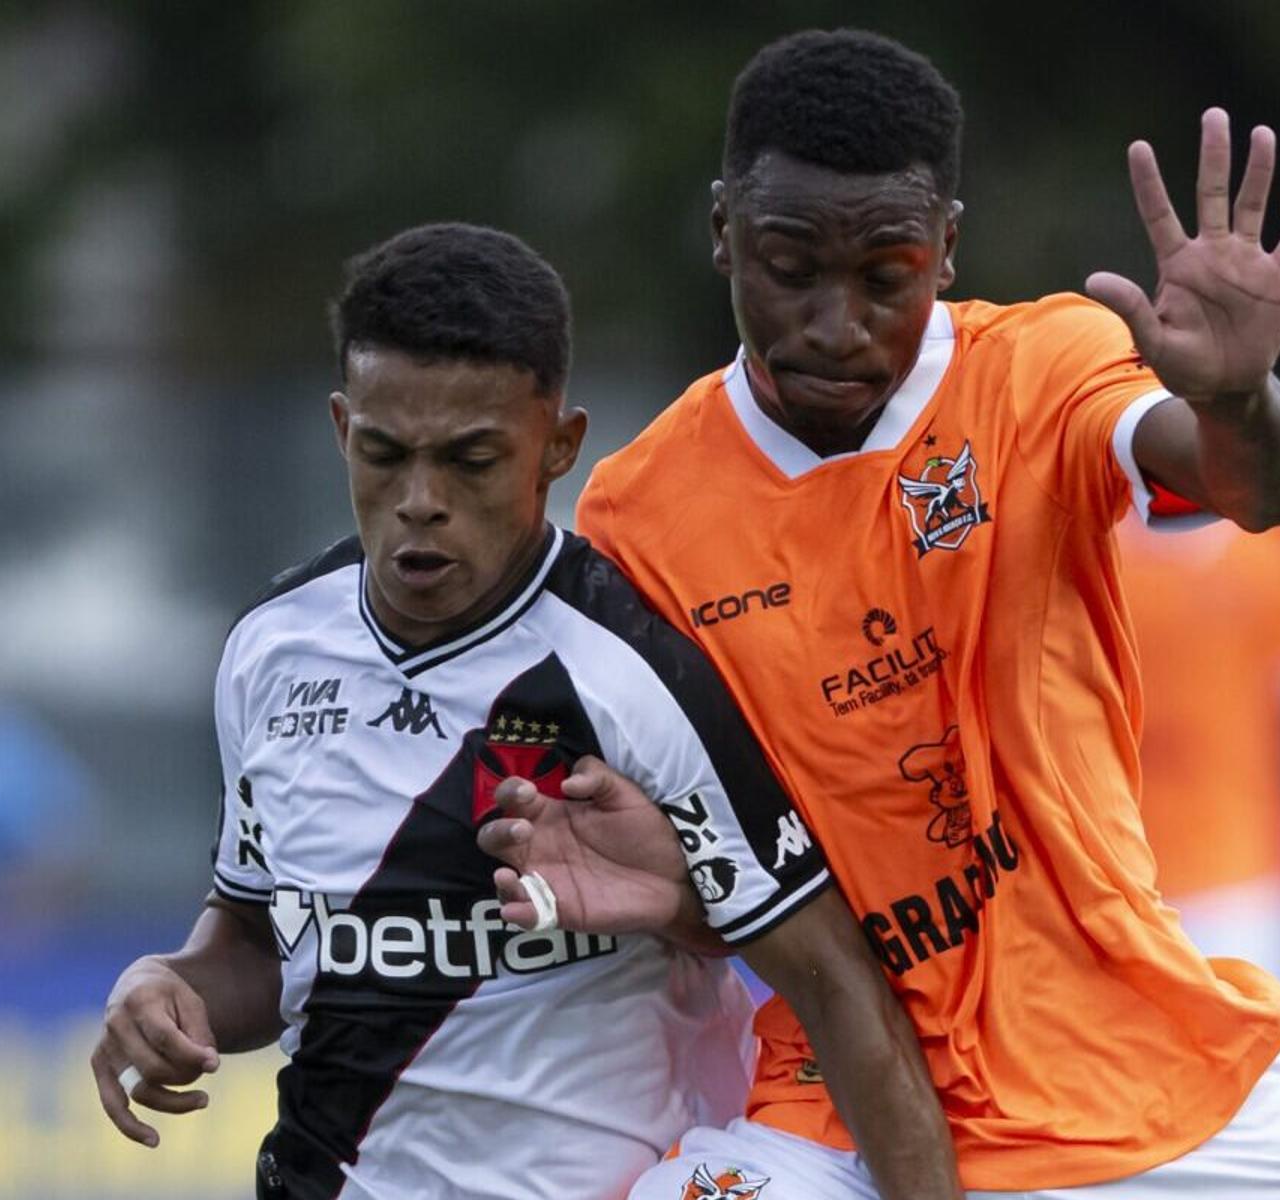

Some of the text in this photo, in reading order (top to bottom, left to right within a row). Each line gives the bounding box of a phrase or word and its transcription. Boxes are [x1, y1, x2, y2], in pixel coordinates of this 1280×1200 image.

[821, 626, 939, 701] FACILIT
[287, 678, 341, 708] VIVA
[266, 707, 348, 742] SORTE
